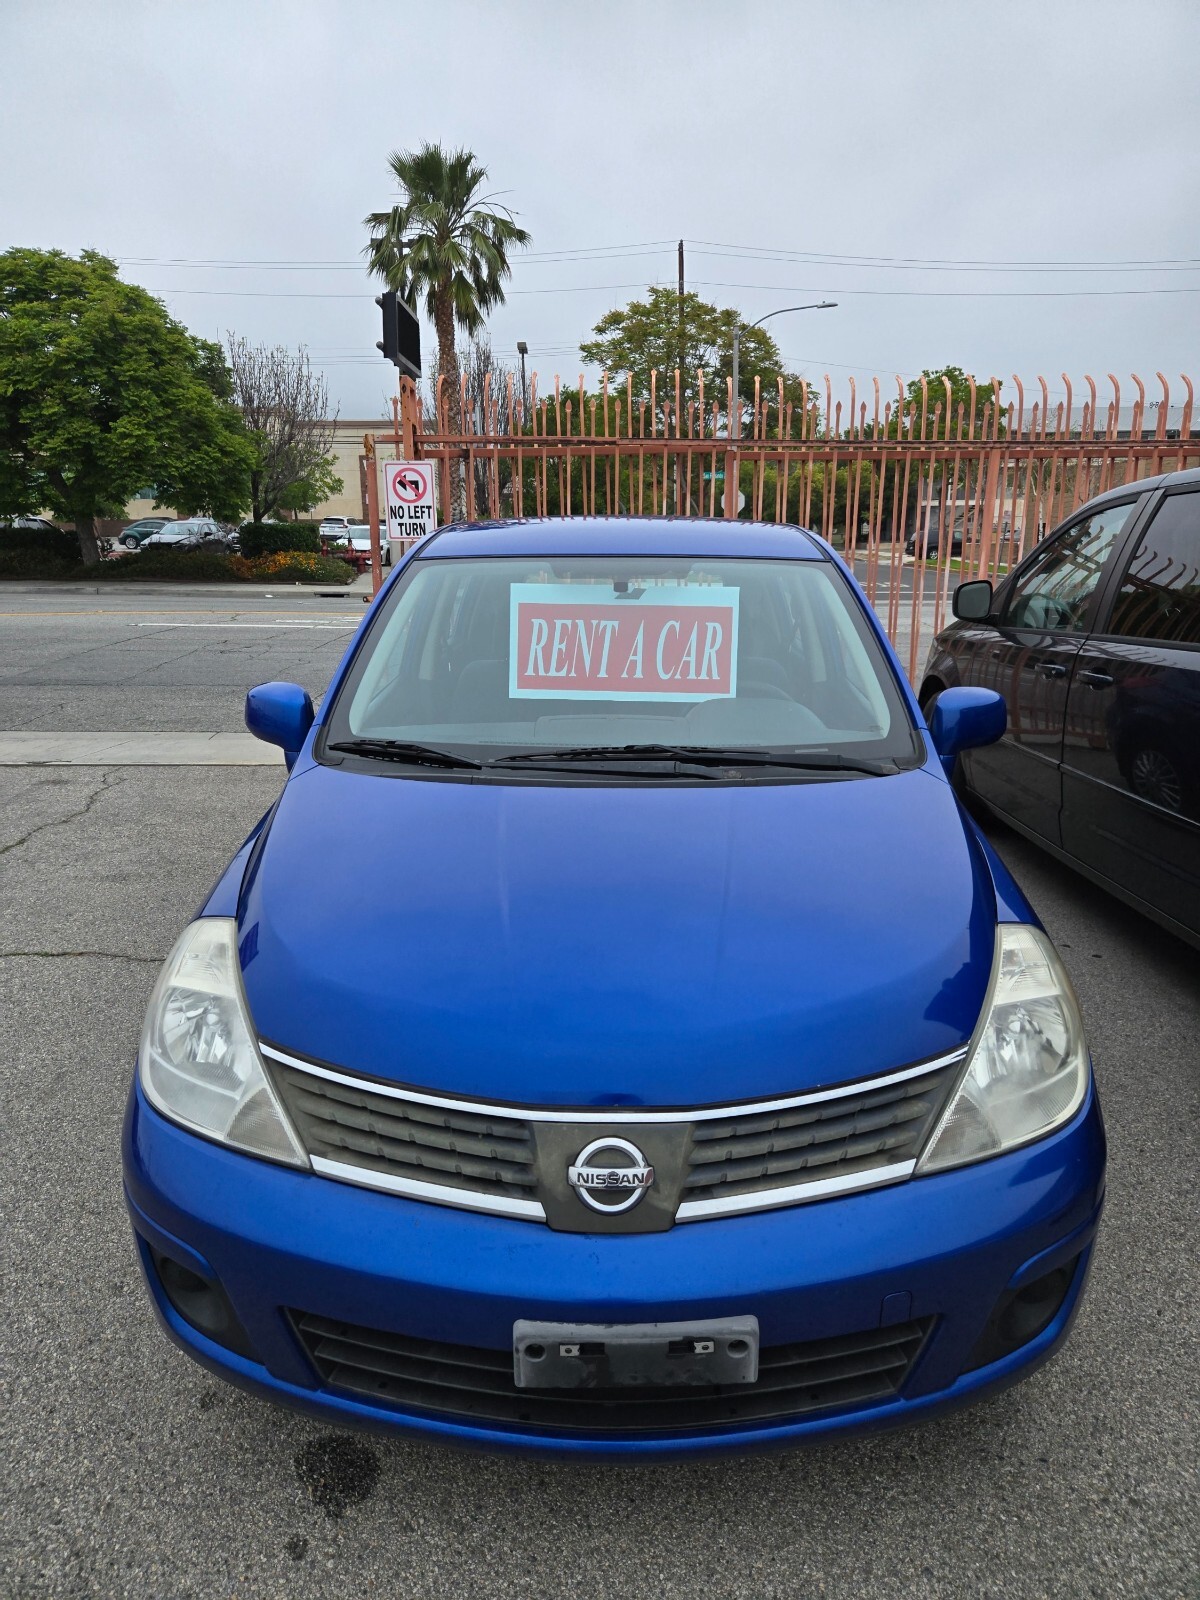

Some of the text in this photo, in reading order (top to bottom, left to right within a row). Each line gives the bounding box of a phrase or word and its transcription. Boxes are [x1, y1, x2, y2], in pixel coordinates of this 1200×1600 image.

[390, 505, 432, 519] NO LEFT
[398, 522, 426, 536] TURN
[524, 618, 723, 680] RENT A CAR
[577, 1172, 645, 1185] NISSAN
